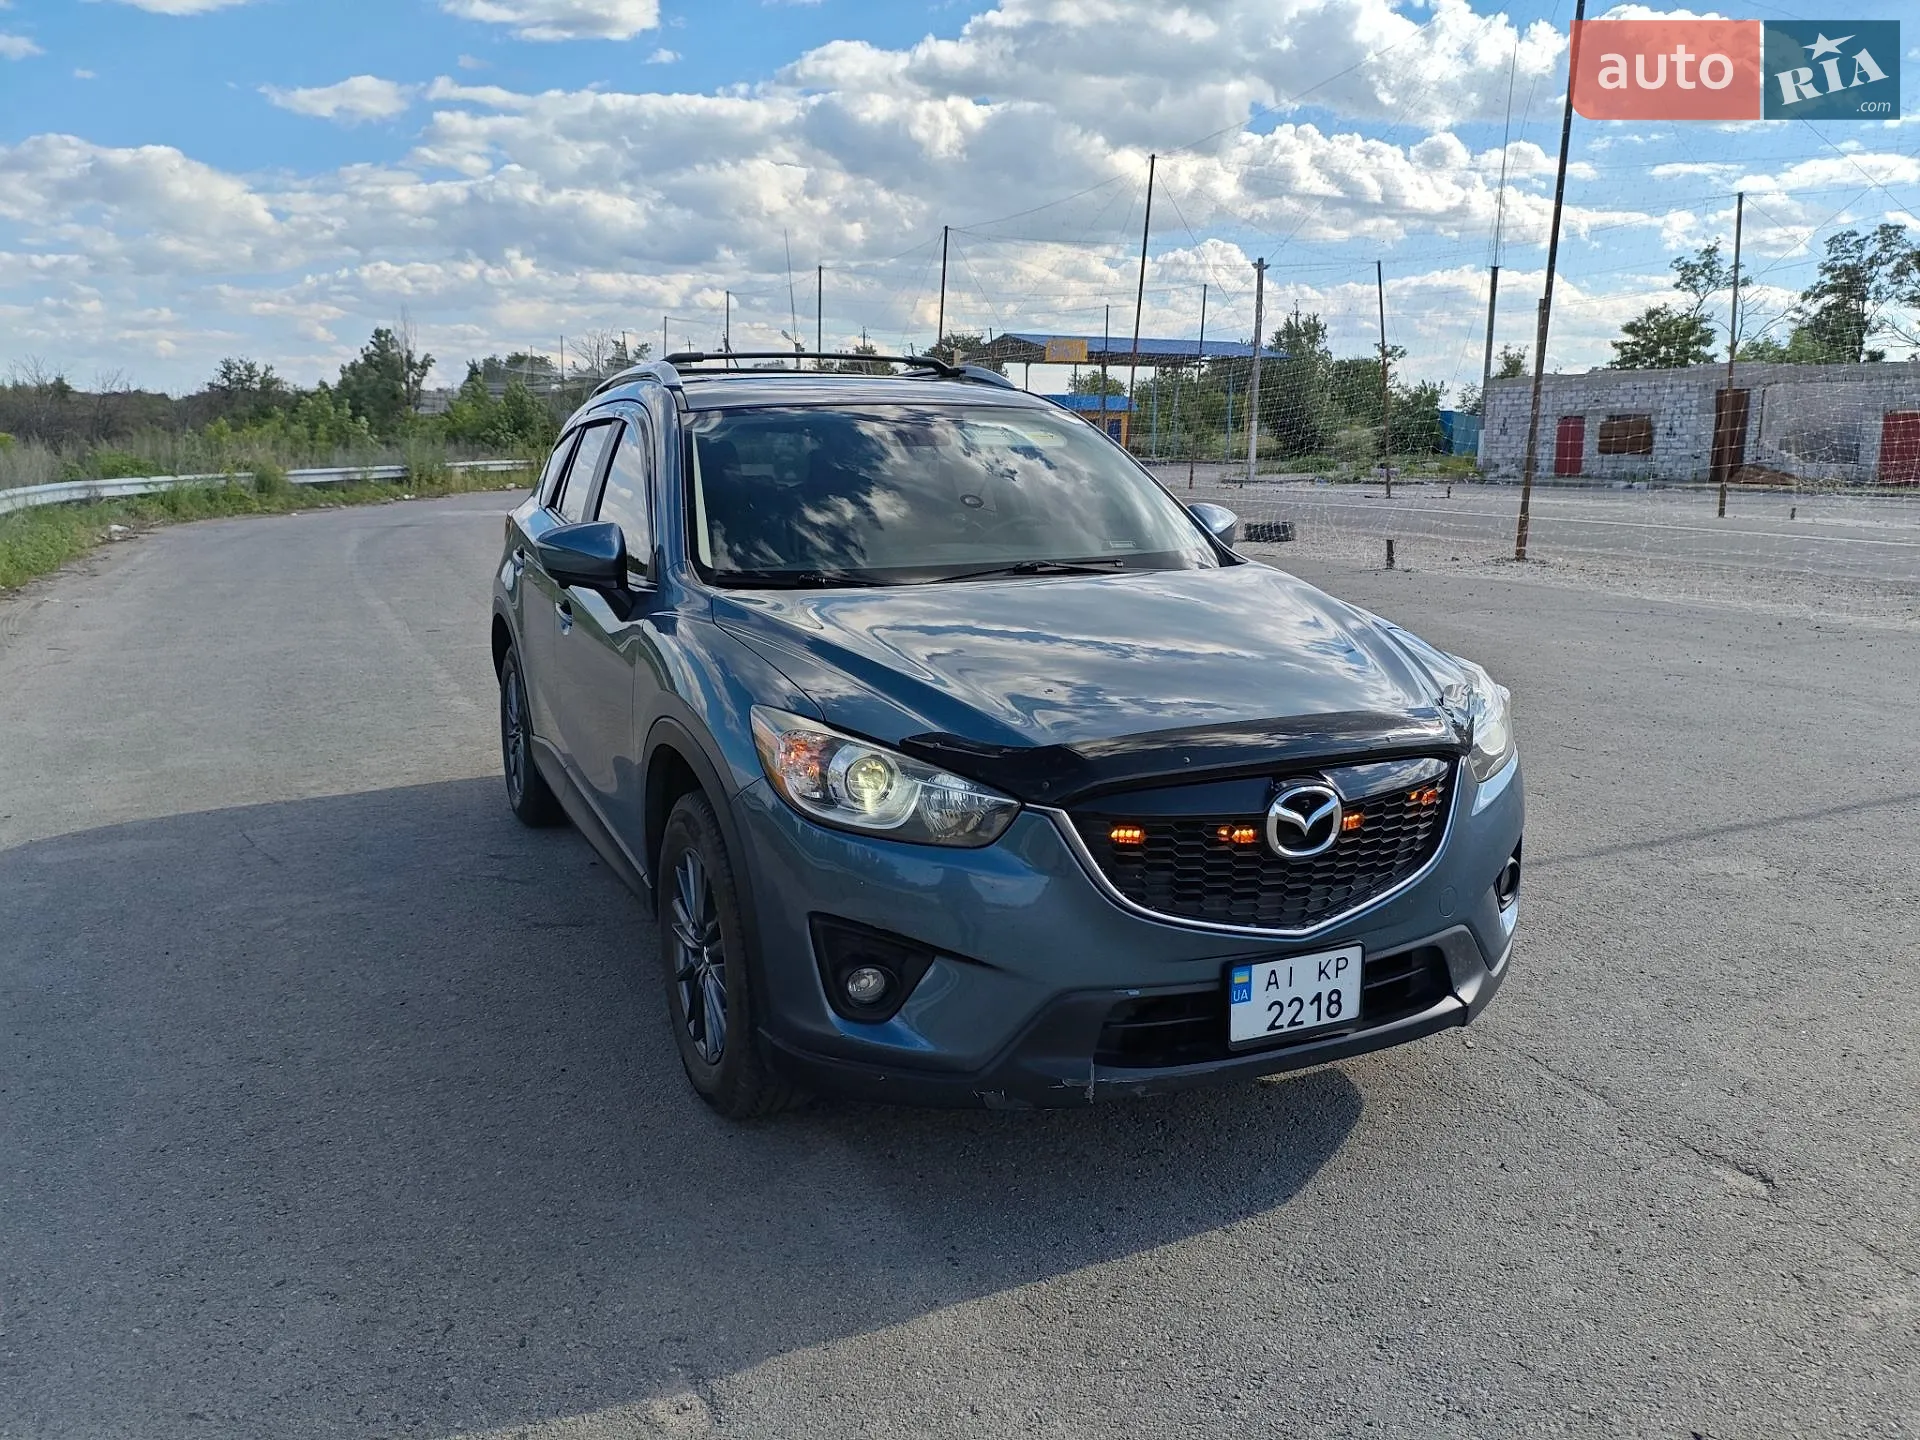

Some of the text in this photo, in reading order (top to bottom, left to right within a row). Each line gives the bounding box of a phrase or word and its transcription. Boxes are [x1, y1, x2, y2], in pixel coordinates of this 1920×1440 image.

[1265, 956, 1349, 992] AI KP
[1233, 988, 1249, 1002] UA
[1266, 988, 1343, 1032] 2218
